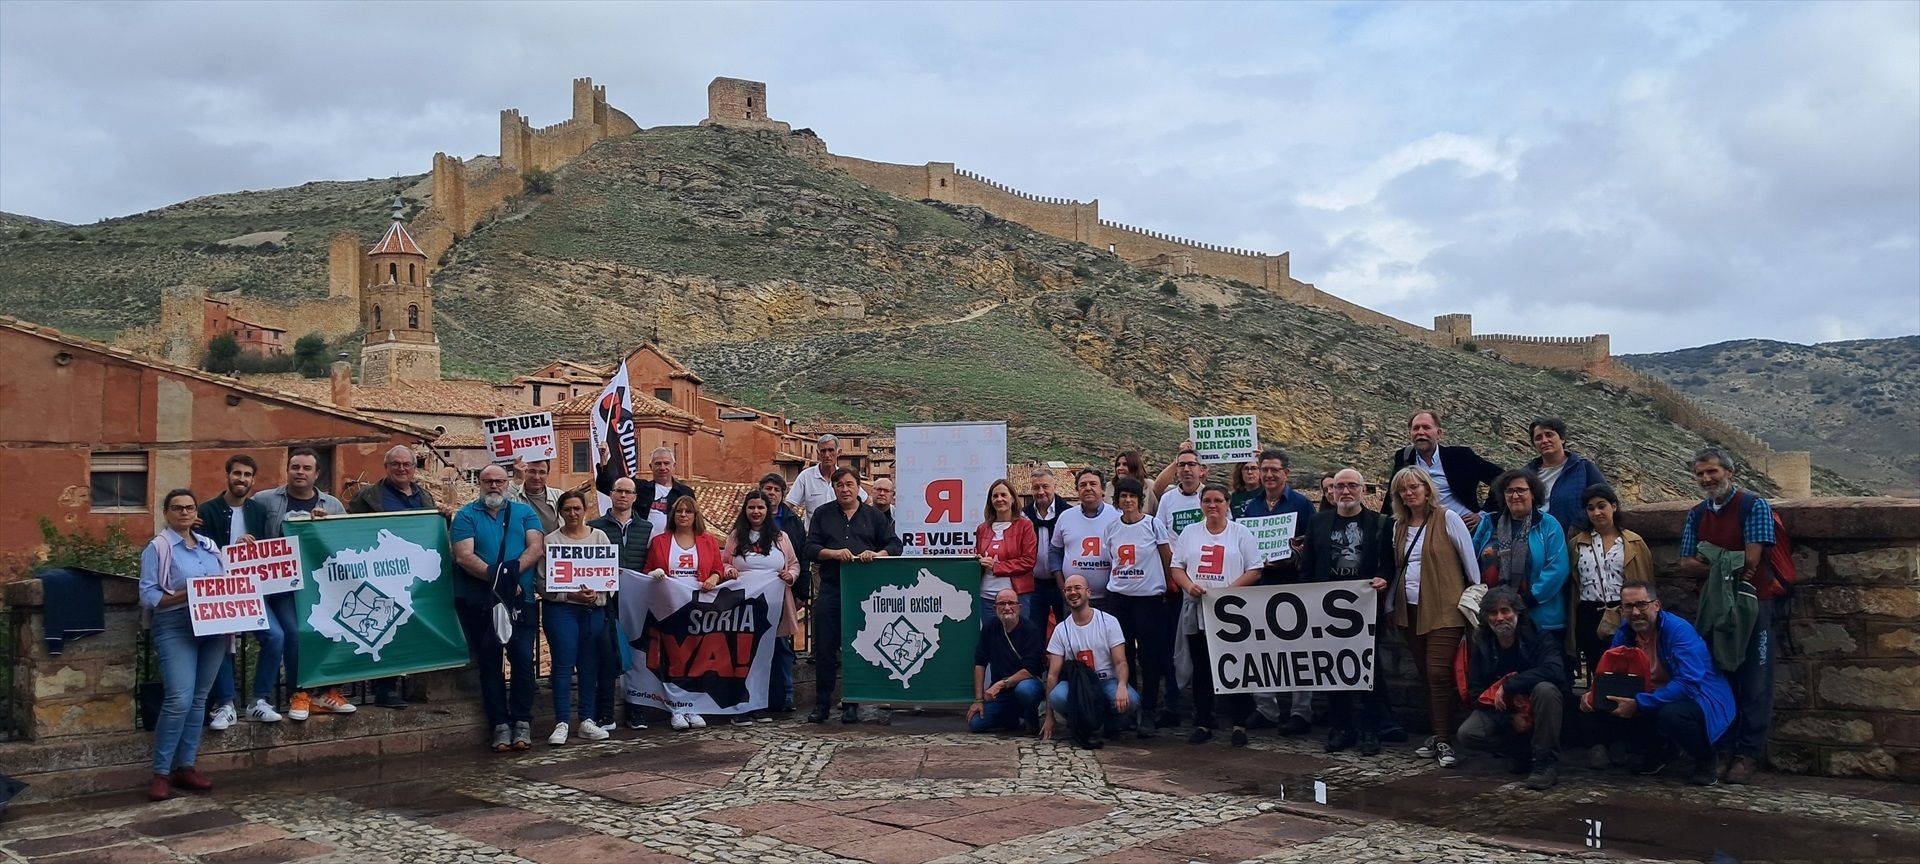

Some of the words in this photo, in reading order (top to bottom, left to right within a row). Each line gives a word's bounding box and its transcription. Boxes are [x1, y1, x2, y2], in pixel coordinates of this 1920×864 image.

[484, 414, 550, 434] TERUEL
[1193, 419, 1214, 428] SER
[1217, 417, 1252, 427] POCOS
[1196, 430, 1211, 439] NO
[1215, 428, 1250, 438] RESTA
[490, 434, 551, 457] ¡EXISTE!
[1195, 439, 1252, 450] DERECHOS
[1262, 515, 1292, 527] POCOS
[902, 532, 977, 546] REVUEL
[1258, 528, 1288, 539] RESTA
[226, 540, 292, 563] TERUEL
[549, 546, 616, 559] TERUEL
[922, 547, 955, 555] España
[1257, 539, 1288, 550] ECHOS
[328, 560, 368, 582] ¡Teruel
[373, 557, 411, 577] existe!
[549, 561, 614, 583] ¡EXISTE!
[193, 577, 256, 597] TERUEL
[193, 599, 263, 621] ¡EXISTE!
[873, 596, 905, 613] ¡Teruel
[910, 596, 942, 613] existe!
[687, 604, 755, 635] SORIA
[1213, 589, 1375, 643] S.O.S.
[647, 627, 754, 678] ¡YA!
[1217, 648, 1373, 690] CAMEROS
